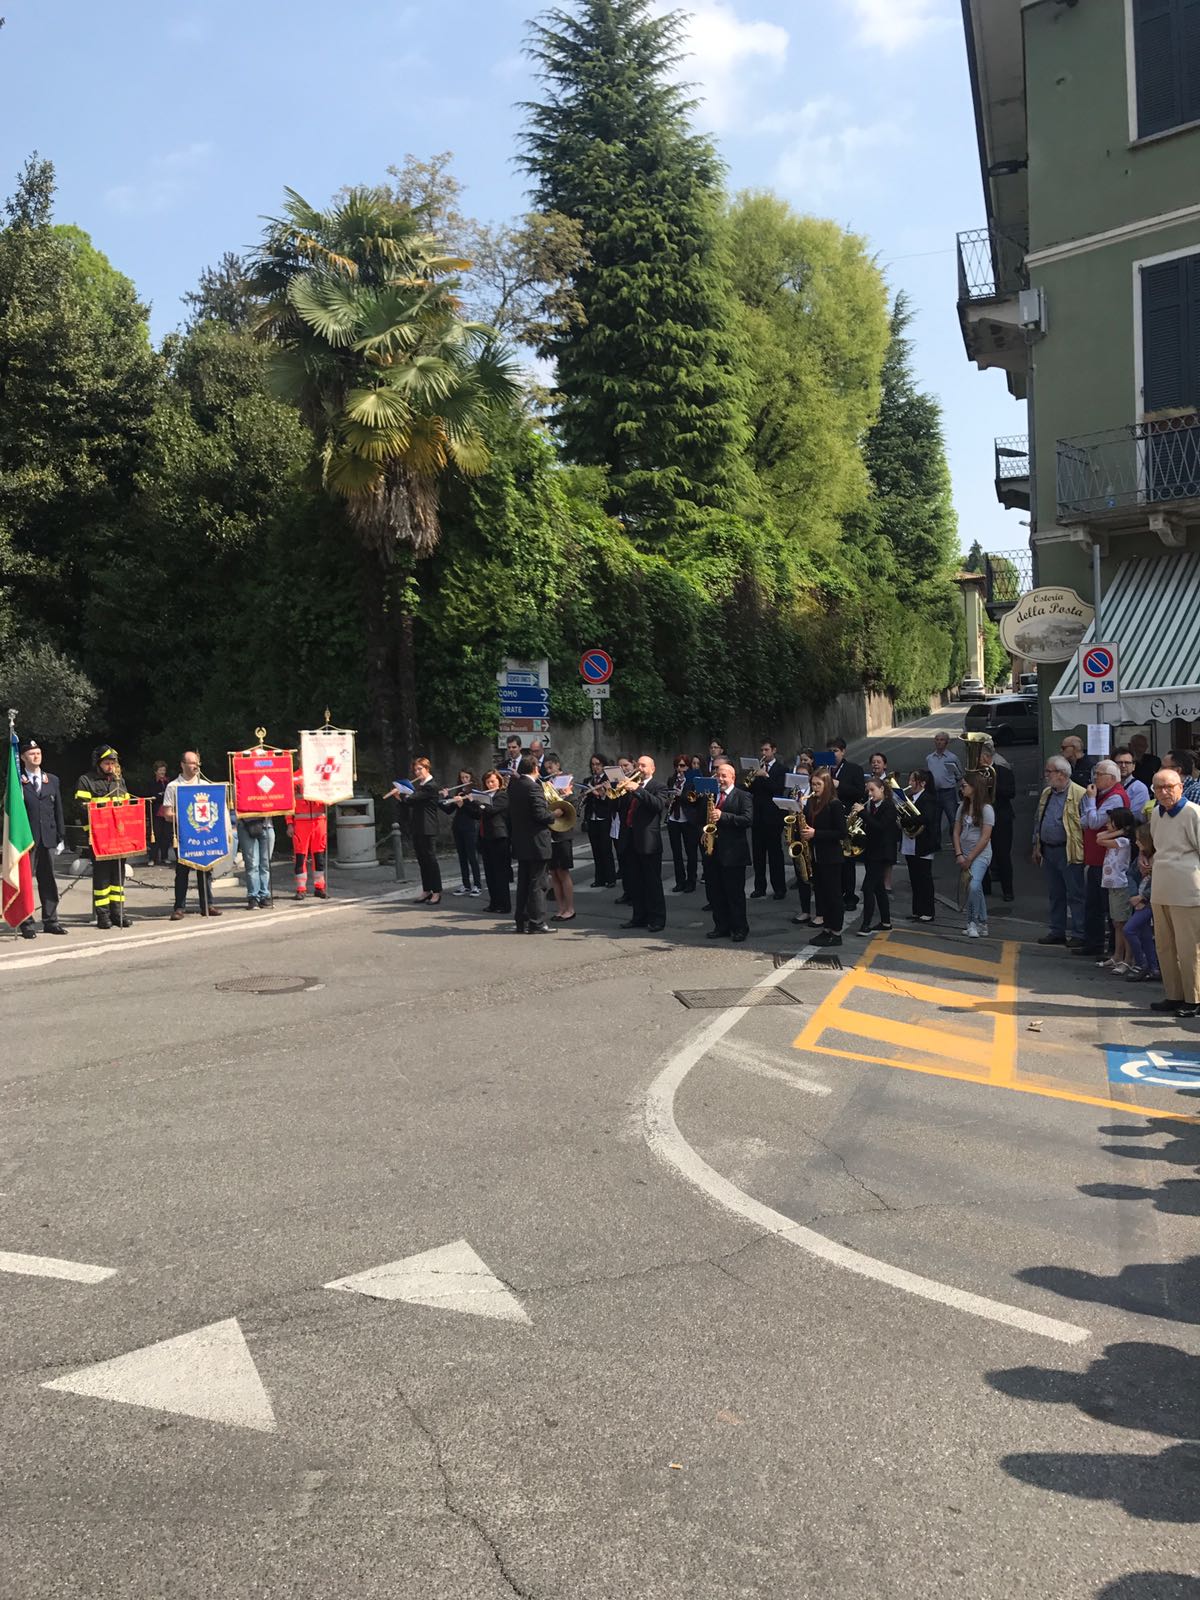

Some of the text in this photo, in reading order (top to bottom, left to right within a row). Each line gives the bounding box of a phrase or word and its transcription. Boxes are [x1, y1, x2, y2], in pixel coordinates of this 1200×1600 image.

[1033, 594, 1064, 603] Osteria
[1016, 602, 1083, 623] della Posta
[1085, 683, 1093, 692] P
[498, 690, 517, 698] COMO
[1151, 698, 1200, 718] Oster
[187, 836, 219, 846] PRO LOCO
